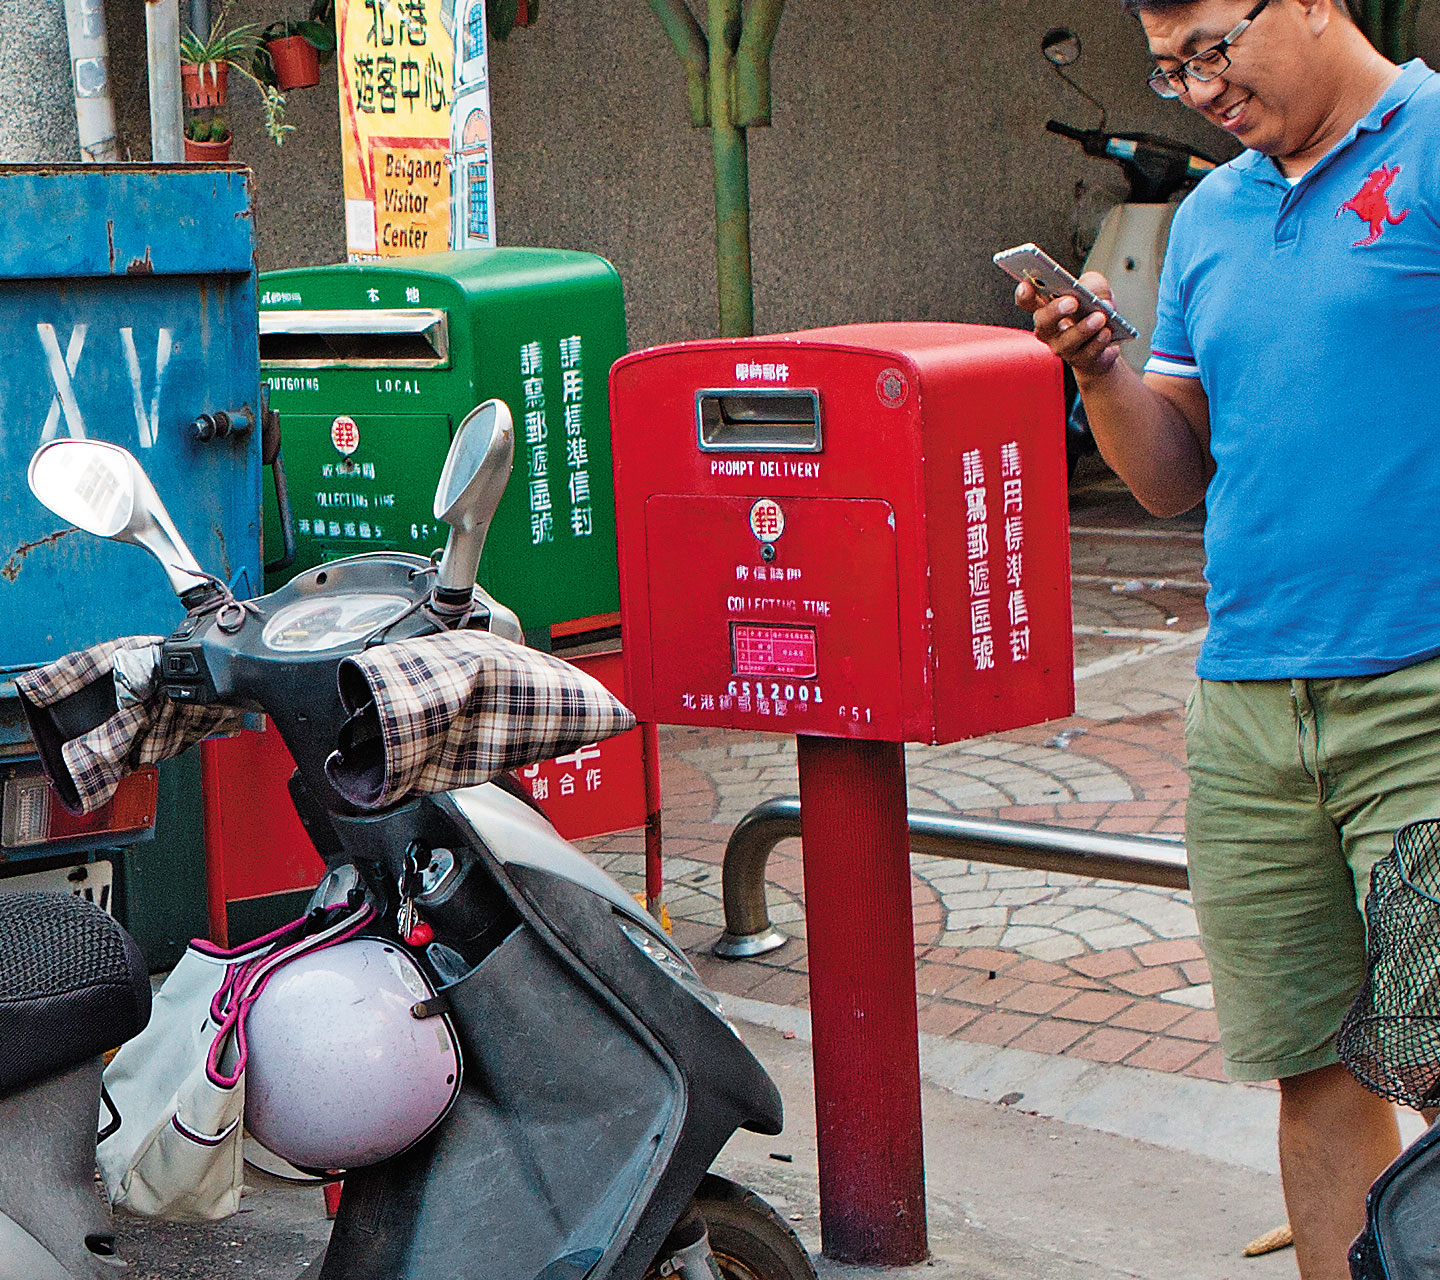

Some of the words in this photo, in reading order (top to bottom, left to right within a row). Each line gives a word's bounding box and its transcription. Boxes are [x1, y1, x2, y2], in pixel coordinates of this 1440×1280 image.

[353, 51, 448, 114] 遊客中心
[385, 153, 442, 187] Beigang
[384, 188, 428, 213] Visitor
[383, 223, 428, 249] Center
[366, 287, 420, 303] 本地
[267, 377, 320, 392] OUTGOING
[375, 379, 421, 394] LOCAL
[520, 341, 554, 545] 請寫郵遞區號
[559, 335, 593, 537] 請用標準信封
[710, 460, 755, 476] PROMPT
[759, 461, 821, 478] DELIVERY
[410, 524, 438, 539] 65
[962, 448, 994, 670] 請寫郵遞區號
[1001, 441, 1030, 662] 請用標準信封
[727, 680, 823, 703] 6512001
[838, 705, 872, 723] 651
